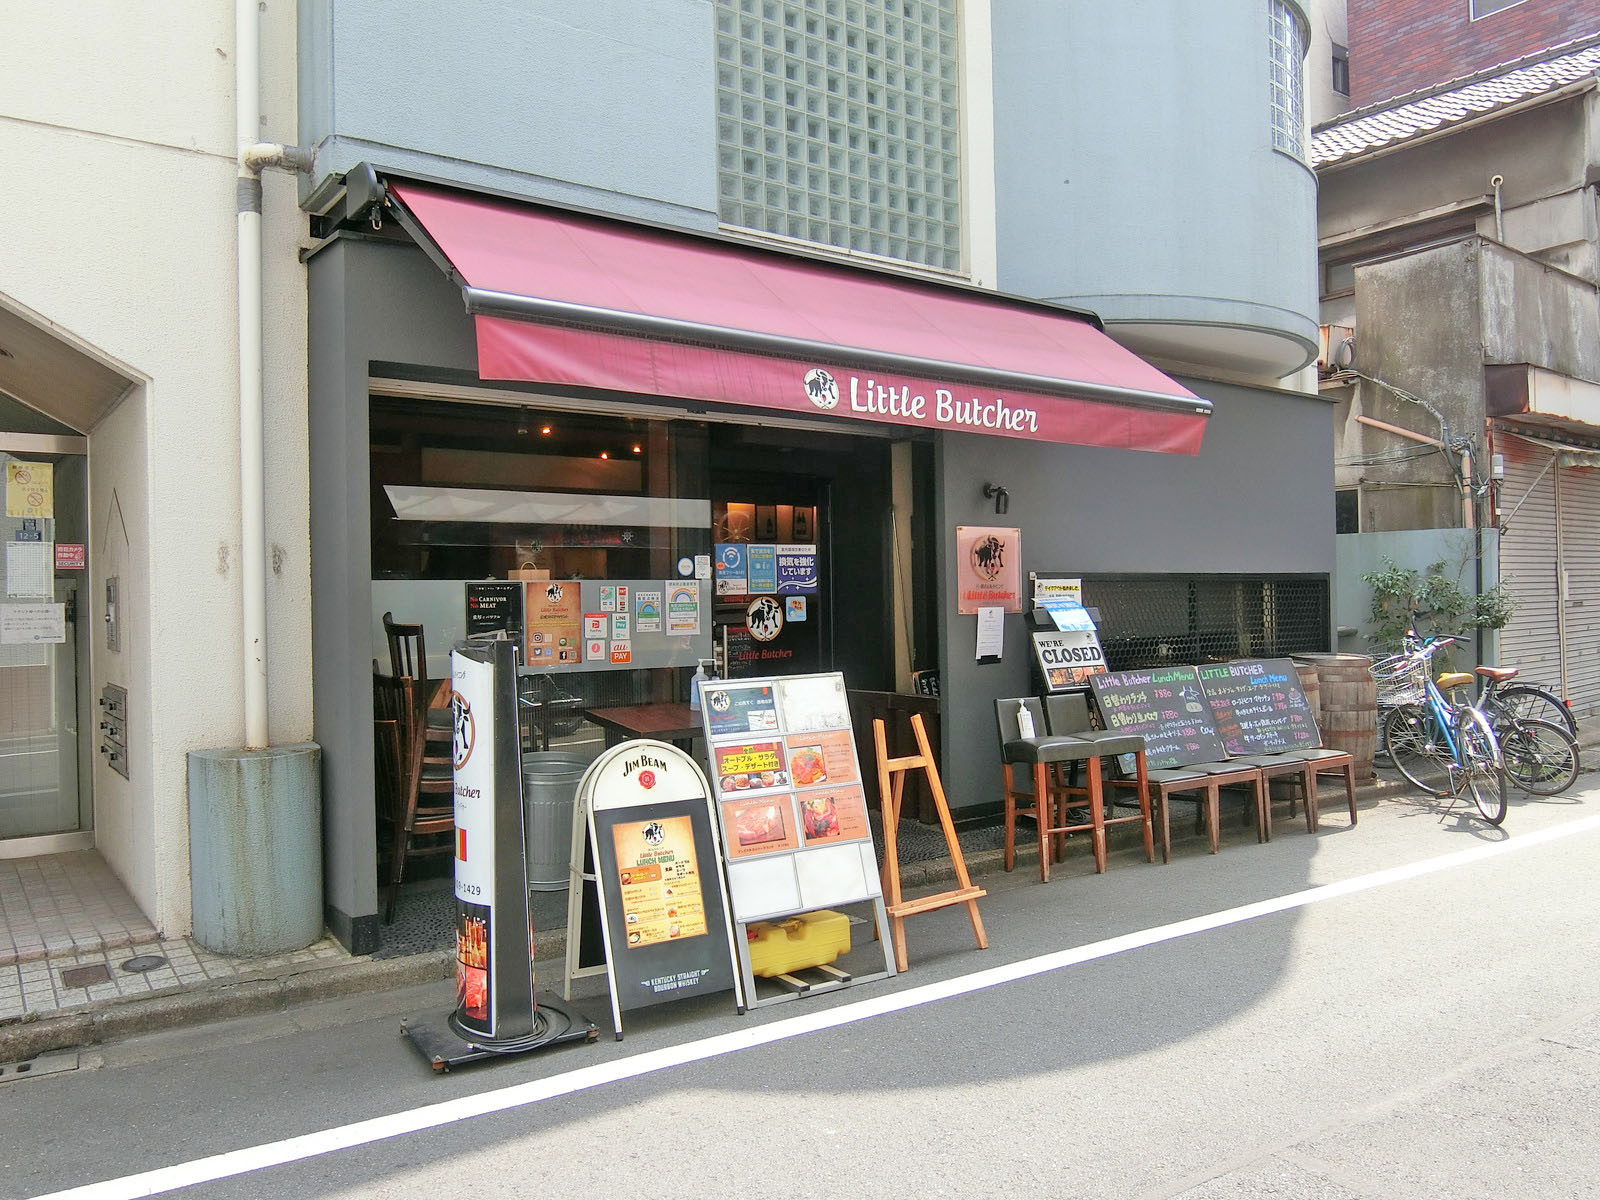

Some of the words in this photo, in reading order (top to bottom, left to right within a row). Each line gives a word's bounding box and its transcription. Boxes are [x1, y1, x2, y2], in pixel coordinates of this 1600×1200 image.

[850, 376, 926, 419] Little
[935, 388, 1039, 433] Butcher
[779, 556, 815, 567] 換気を強化
[781, 567, 812, 576] しています
[1038, 640, 1064, 648] WE'RE
[614, 652, 628, 660] PAY
[738, 650, 760, 660] Little
[761, 648, 793, 659] Butcher
[1041, 646, 1102, 665] CLOSED
[1199, 667, 1230, 680] LITTLE
[1250, 674, 1269, 685] Lunch
[1268, 673, 1289, 683] Menu
[1096, 676, 1121, 690] Little
[1121, 674, 1152, 687] Butcher
[1152, 672, 1174, 683] Lunch
[1174, 671, 1195, 682] Menu
[1102, 691, 1148, 709] 日替わりランチ
[623, 760, 640, 777] JIM
[640, 755, 667, 772] BEAM
[636, 857, 657, 867] LUNCH
[658, 855, 675, 864] MENU
[651, 975, 677, 986] KENTUCKY
[677, 970, 701, 980] STRAIGHT
[678, 977, 700, 988] WHISKEY
